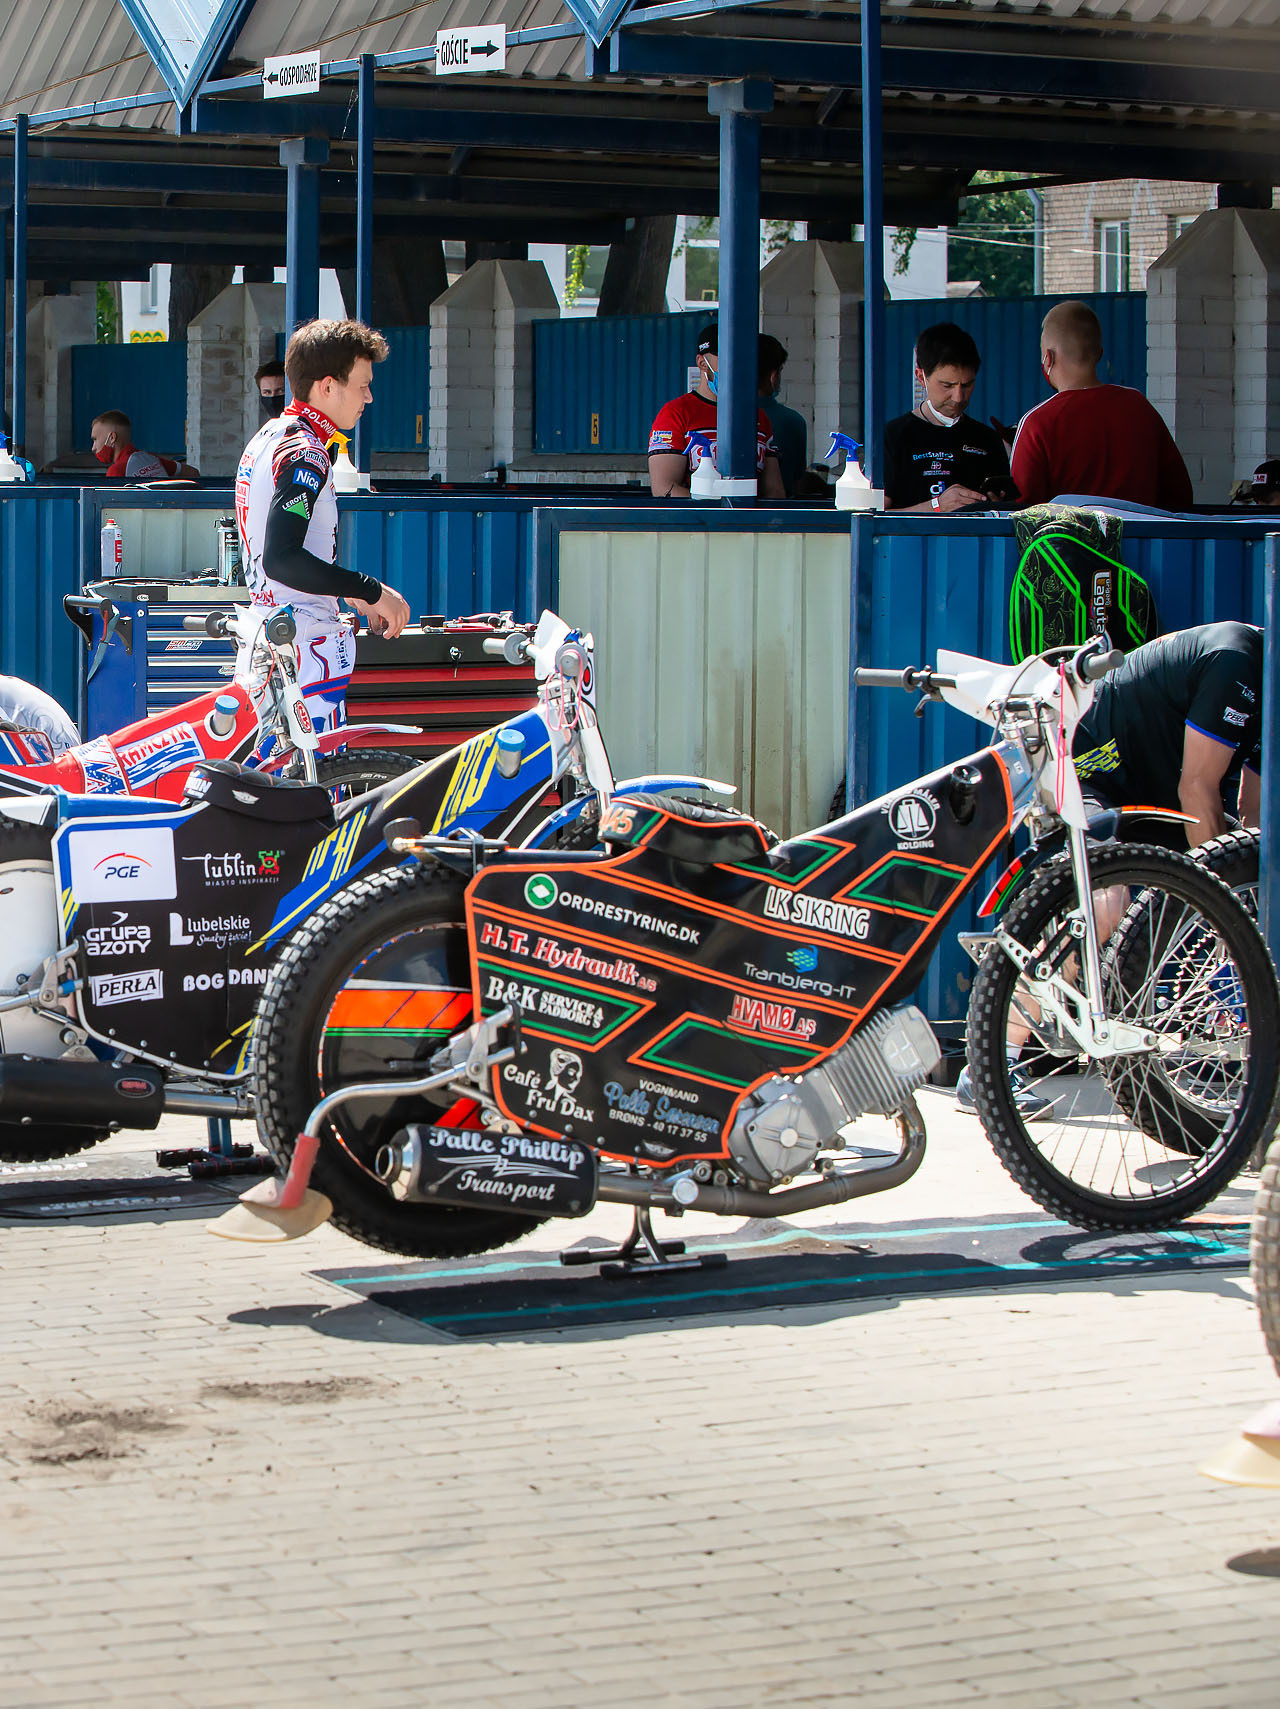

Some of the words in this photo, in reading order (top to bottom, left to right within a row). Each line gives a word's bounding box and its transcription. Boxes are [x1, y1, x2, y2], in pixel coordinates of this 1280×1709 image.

[441, 35, 469, 66] GOŚCIE
[278, 62, 318, 86] GOSPODARZE
[301, 407, 338, 437] POLONIA
[295, 469, 320, 491] Nice
[282, 496, 307, 510] LEROY
[1093, 571, 1110, 635] Laguta
[897, 840, 935, 851] KOLDING
[104, 865, 141, 880] PGE
[205, 879, 236, 887] MIASTO
[558, 891, 701, 945] ORDRESTYRING.DK
[763, 885, 794, 921] LK
[790, 893, 871, 940] SIKRING
[480, 922, 530, 956] H.T.
[531, 935, 641, 987] Hydraulik
[98, 975, 158, 999] PERŁA
[485, 975, 541, 1011] B&K
[743, 961, 857, 999] Tranbjerg-IT
[540, 990, 596, 1018] SERVICE
[730, 994, 797, 1030] HVAMØ
[503, 1063, 542, 1090] Café
[639, 1079, 700, 1104] VOGNMAND
[524, 1088, 558, 1113] Fru
[560, 1096, 596, 1123] Dax
[603, 1081, 651, 1116] Palle
[666, 1123, 679, 1136] 17
[679, 1127, 693, 1139] 37
[693, 1131, 708, 1143] 55
[429, 1128, 497, 1154] Palle
[499, 1135, 586, 1172] Phillip
[456, 1169, 557, 1203] Transport
